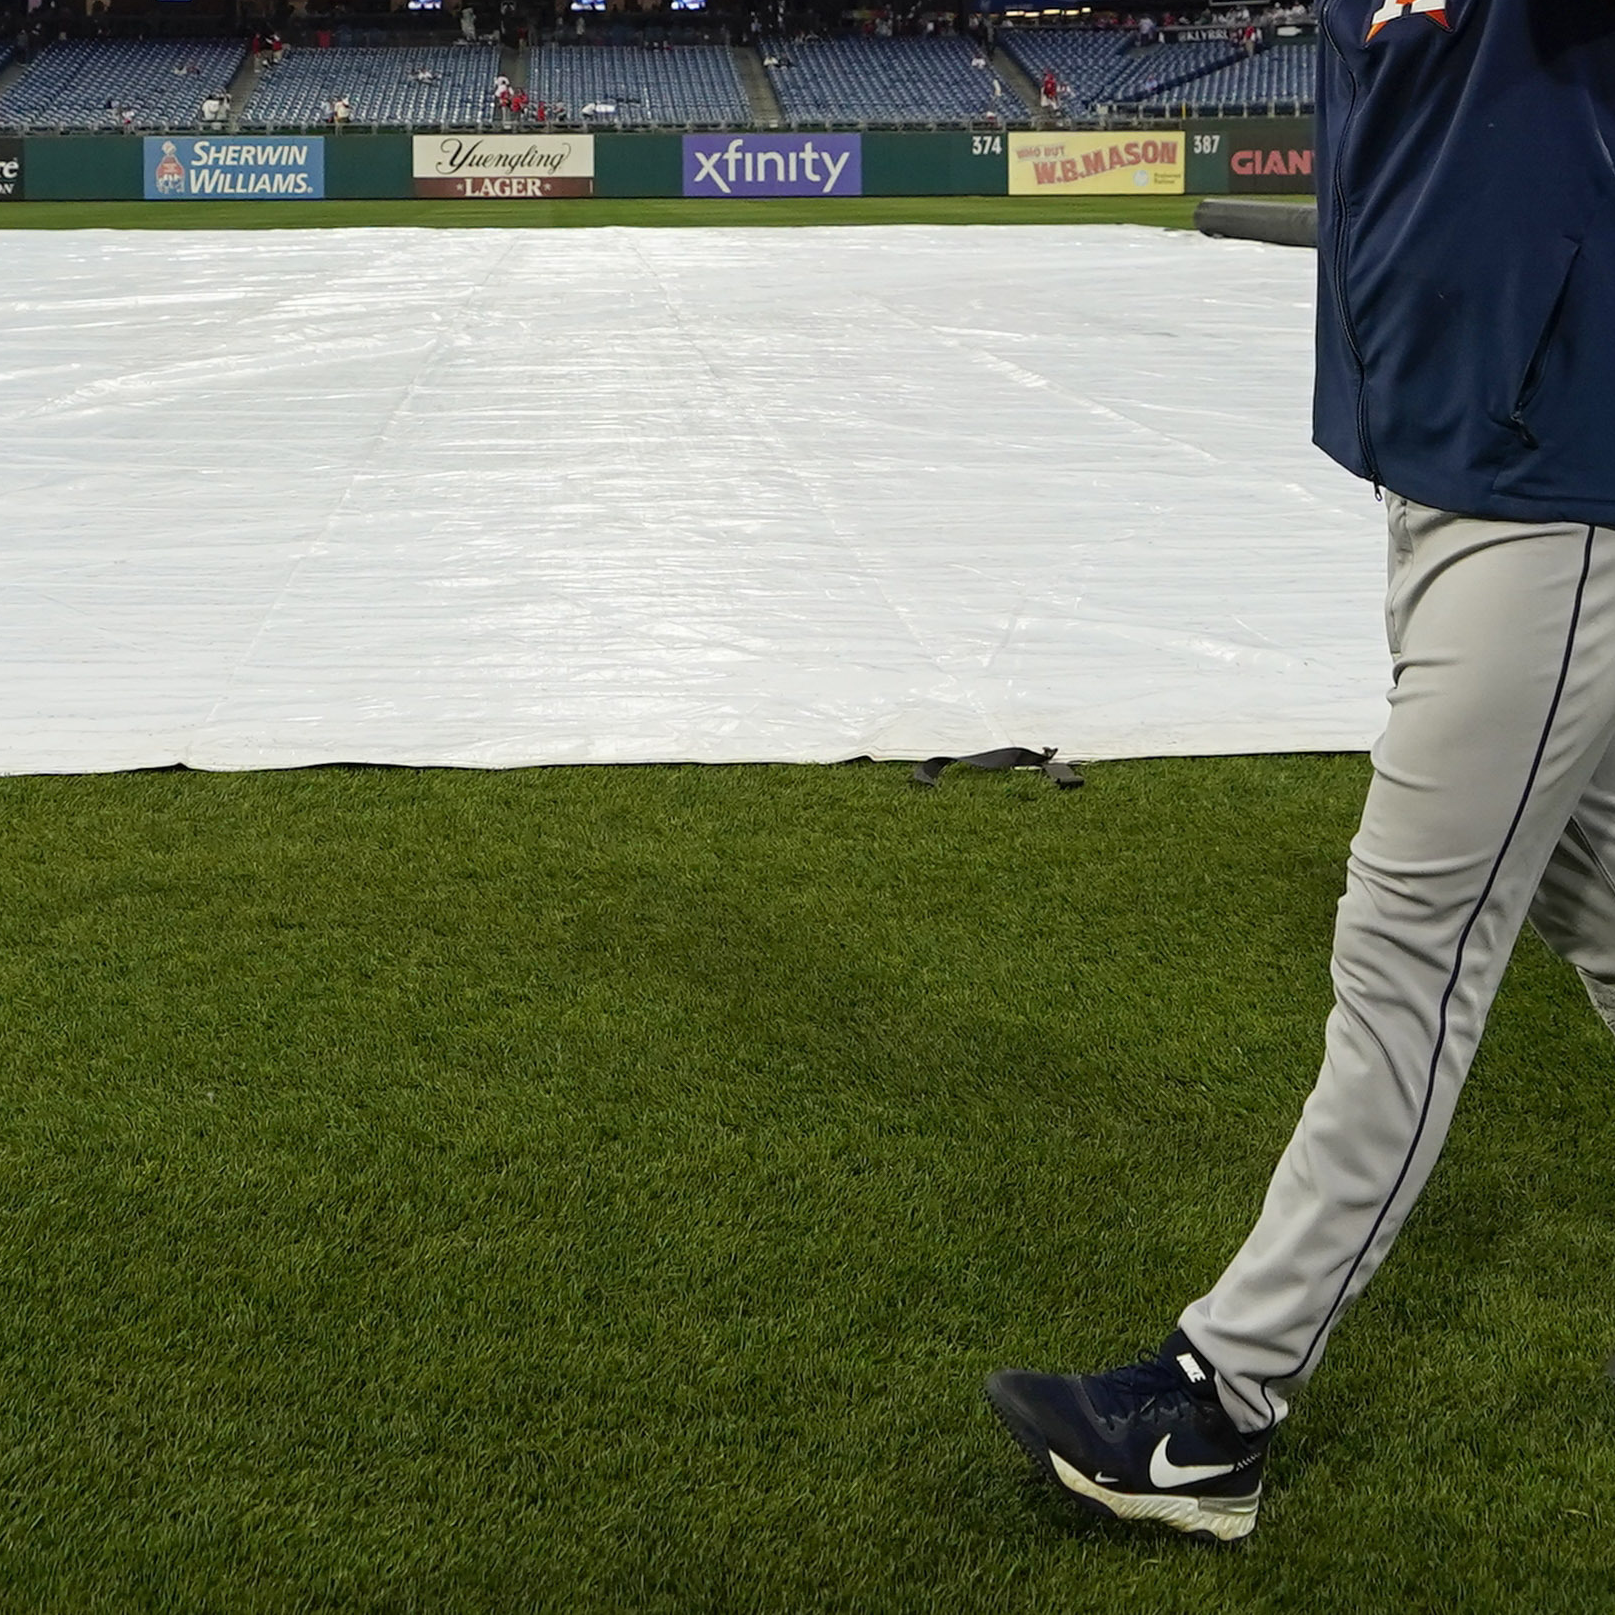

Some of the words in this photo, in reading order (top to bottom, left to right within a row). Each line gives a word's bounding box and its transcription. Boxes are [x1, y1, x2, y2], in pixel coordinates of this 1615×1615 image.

[191, 140, 307, 166] SHERWIN
[972, 136, 1002, 155] 374
[1016, 146, 1041, 159] WHO
[1044, 145, 1065, 157] BUT
[1193, 135, 1220, 154] 387
[435, 138, 572, 175] Yuengling
[694, 139, 850, 194] xfinity
[464, 178, 543, 197] LAGER
